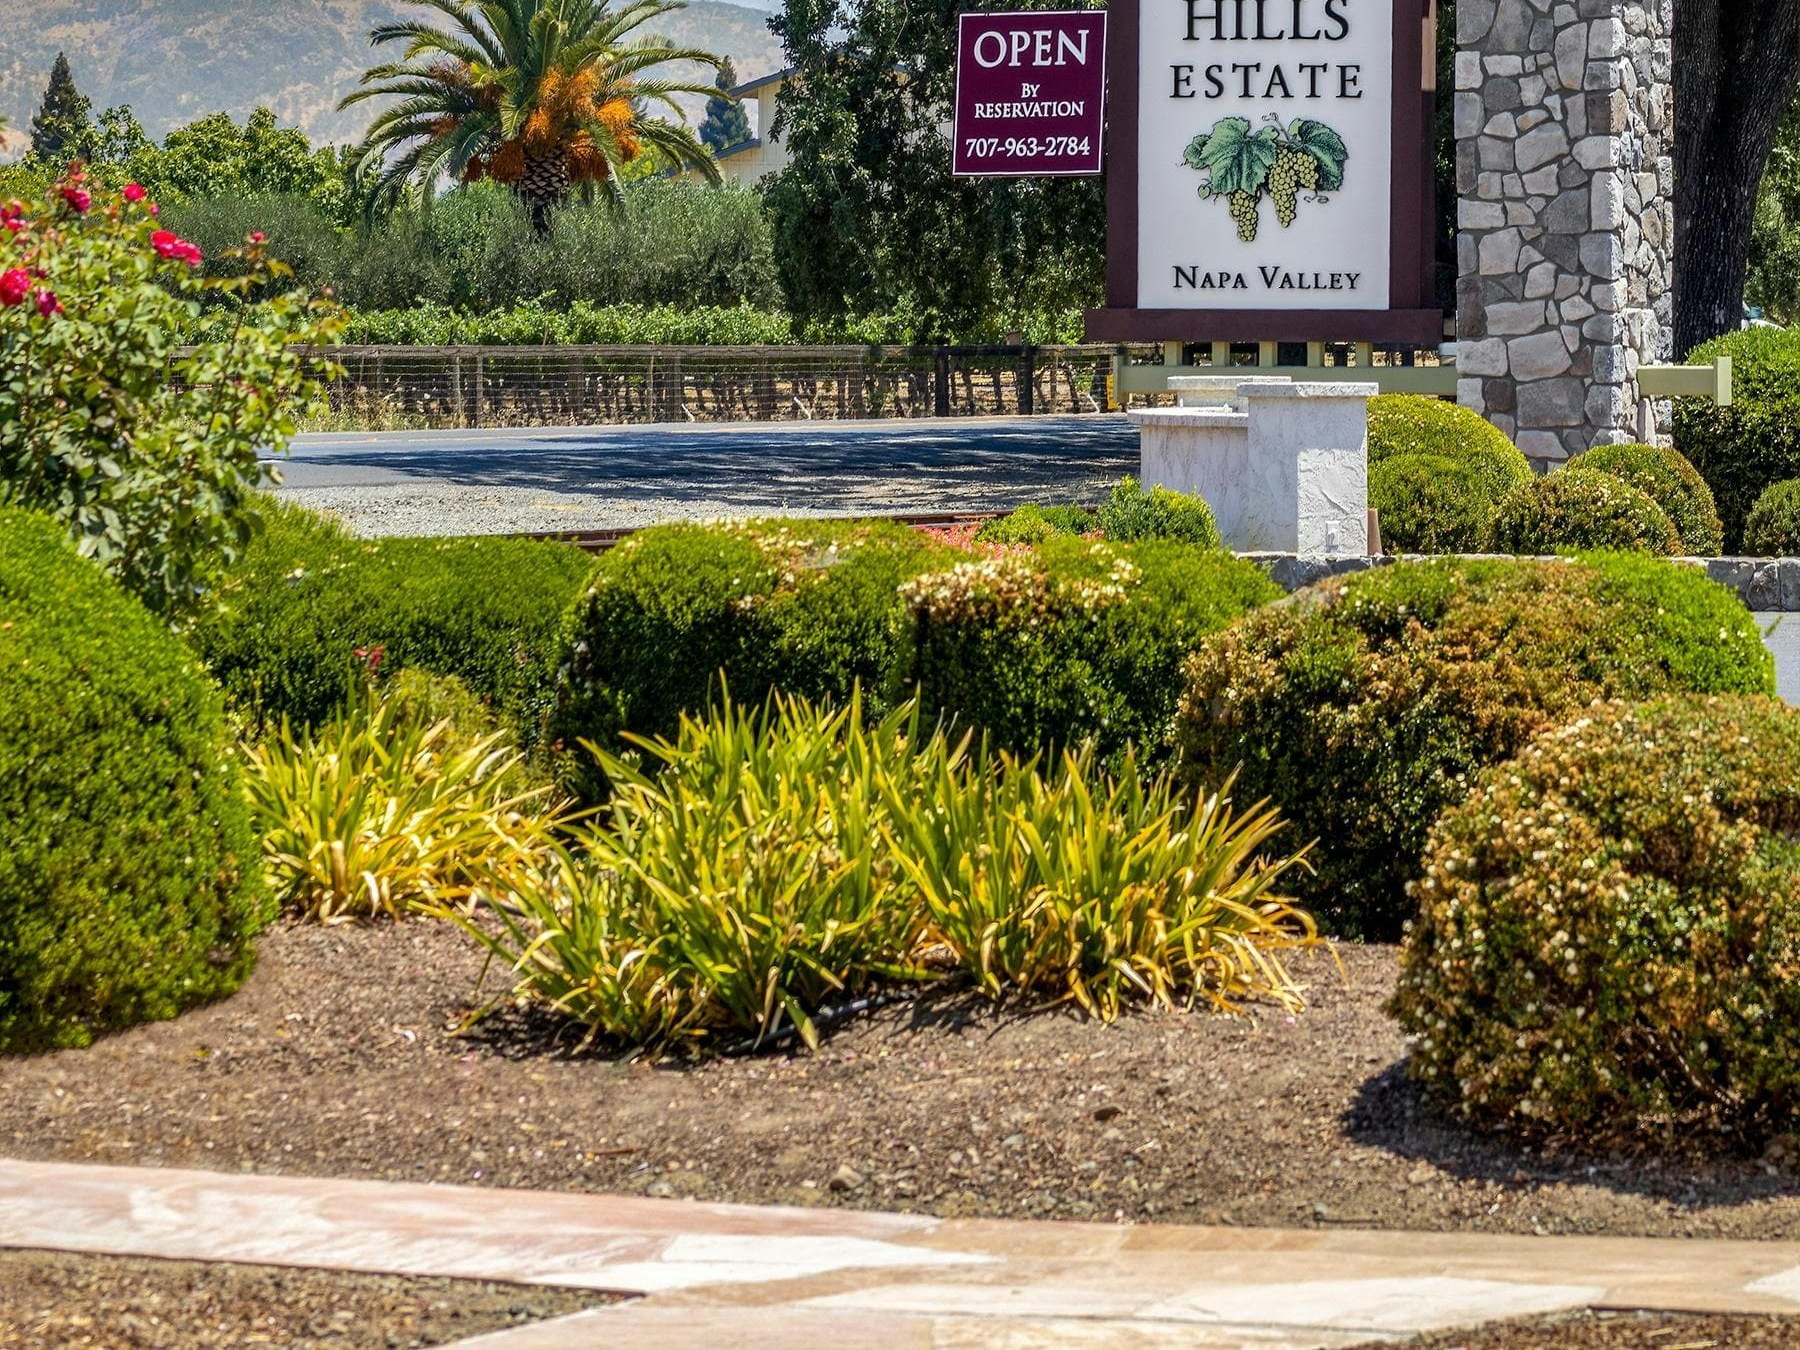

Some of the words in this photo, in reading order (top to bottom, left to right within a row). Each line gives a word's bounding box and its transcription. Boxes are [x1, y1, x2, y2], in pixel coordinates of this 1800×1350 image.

[973, 29, 1090, 68] OPEN
[1020, 82, 1041, 99] BY
[1168, 61, 1363, 100] ESTATE
[974, 100, 1085, 119] RESERVATION
[965, 135, 1091, 158] 707-963-2784
